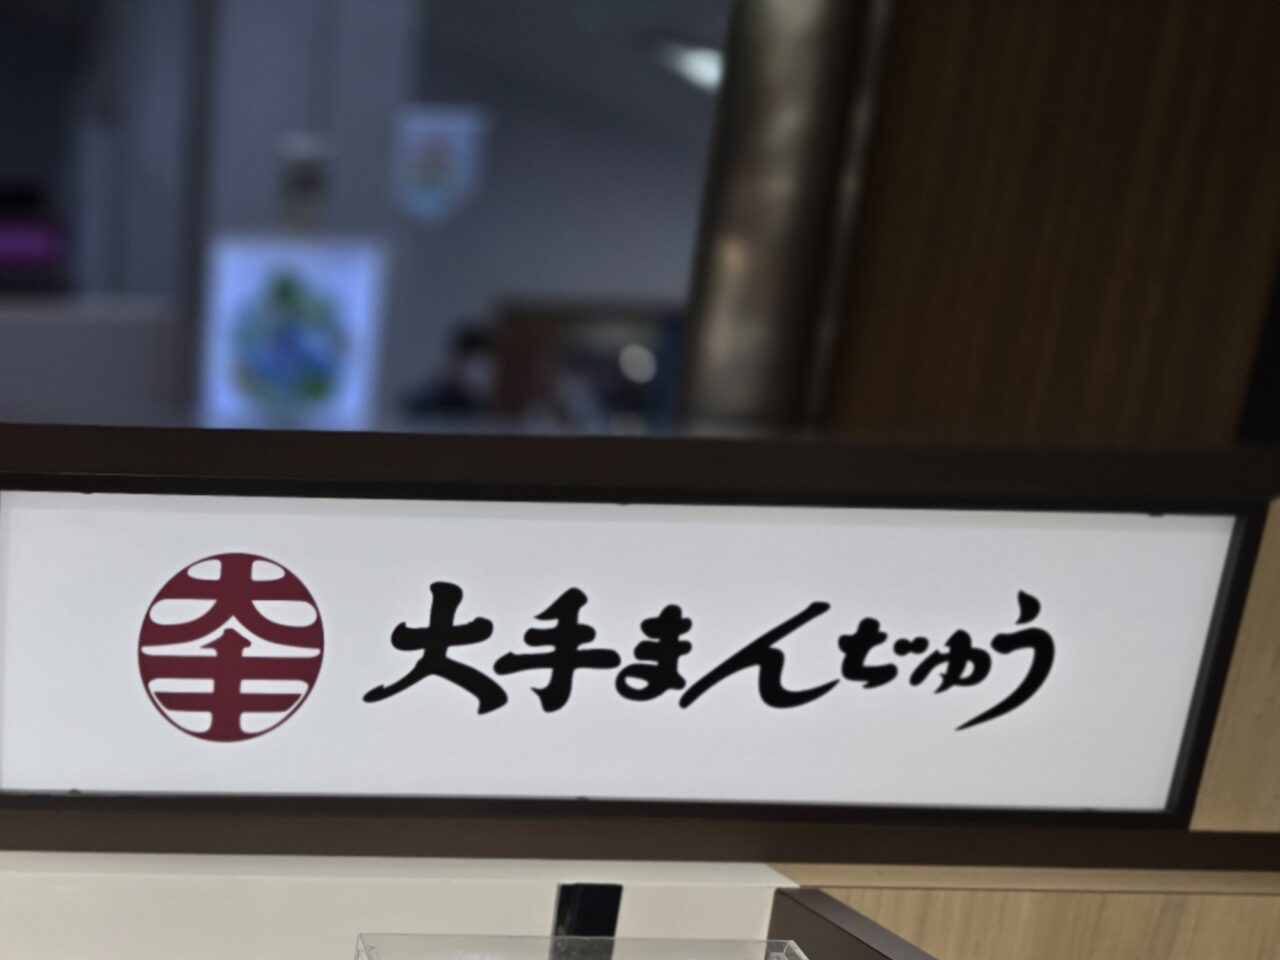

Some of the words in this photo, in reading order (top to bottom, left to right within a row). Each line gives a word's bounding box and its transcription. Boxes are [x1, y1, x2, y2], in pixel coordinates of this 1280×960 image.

[363, 582, 1055, 730] 大手まんぢゅう
